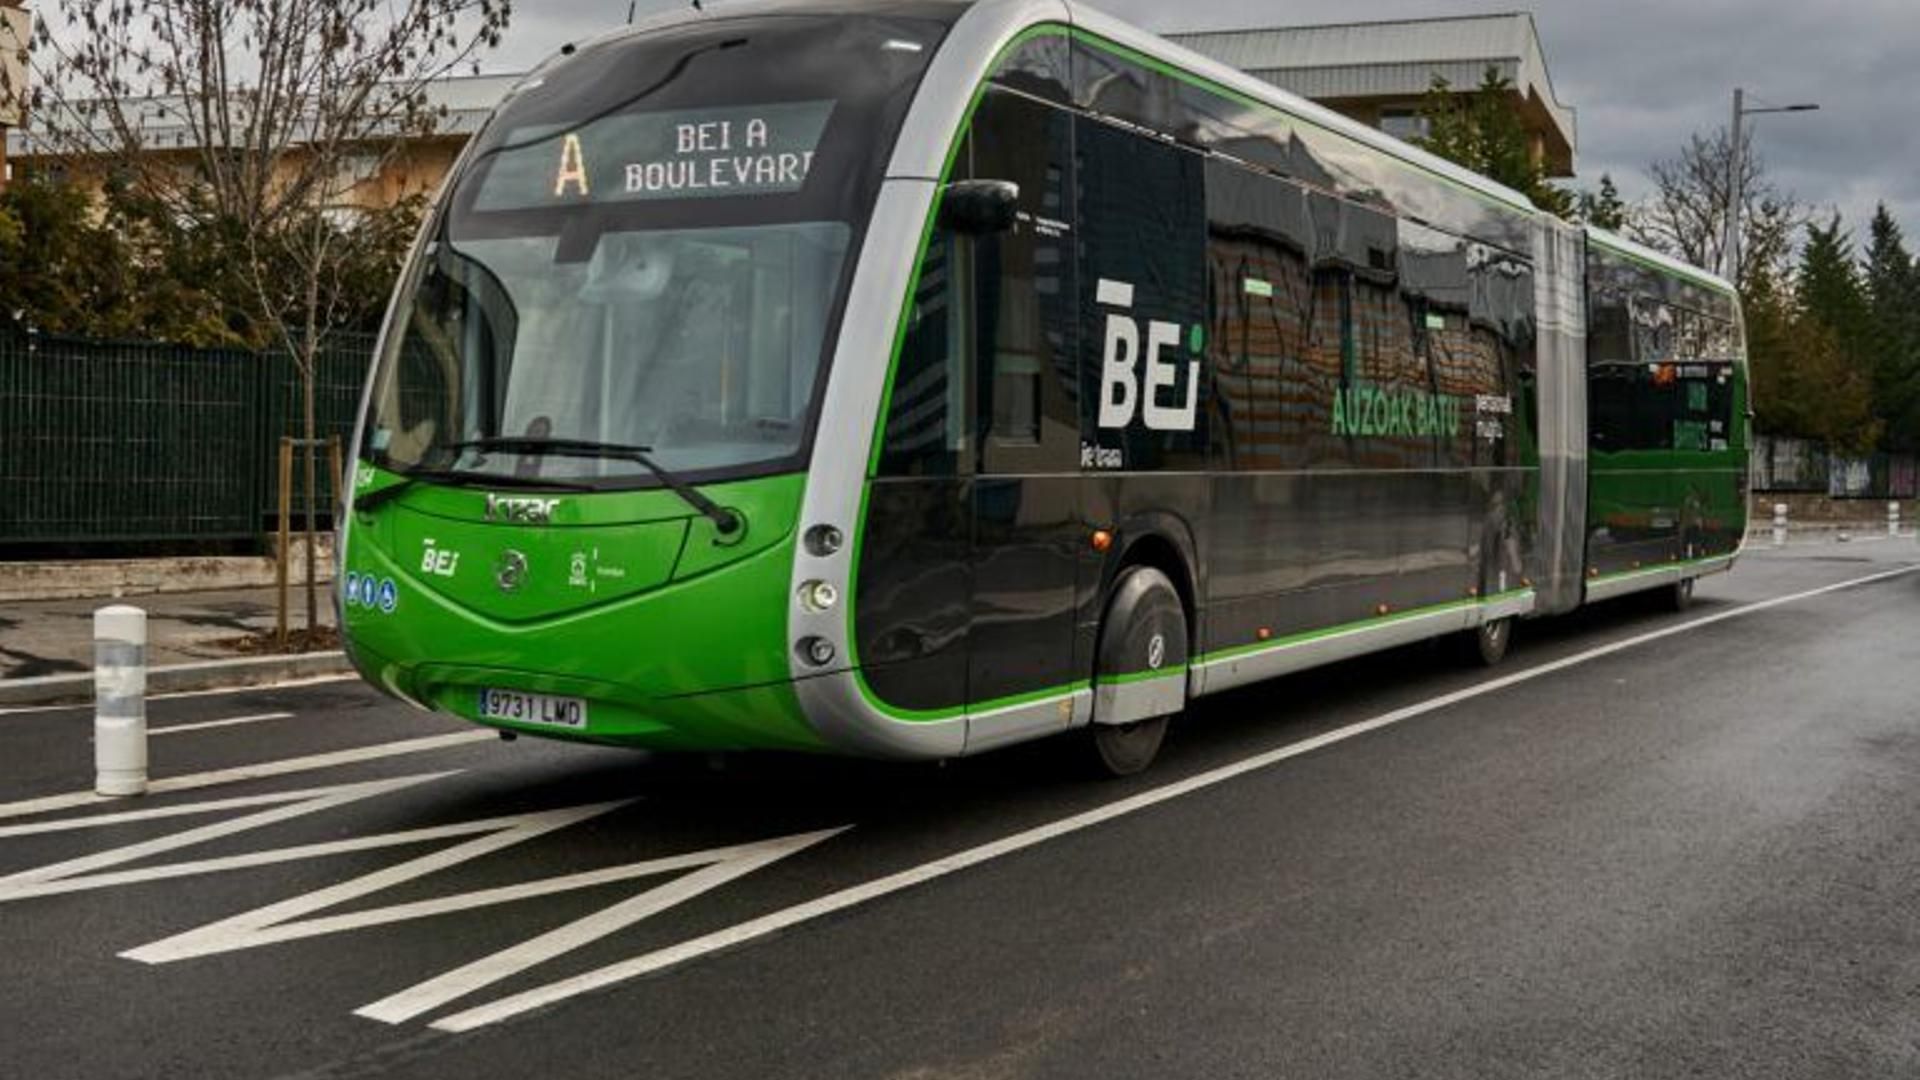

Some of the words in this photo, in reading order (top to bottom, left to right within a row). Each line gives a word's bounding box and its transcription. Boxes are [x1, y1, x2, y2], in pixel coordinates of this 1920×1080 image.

[676, 120, 731, 153] BEI
[746, 118, 768, 148] A
[555, 132, 588, 196] A
[1332, 387, 1415, 437] AUZOAK
[1416, 393, 1459, 437] BATU
[489, 690, 533, 720] 9731
[541, 699, 581, 725] LMD
